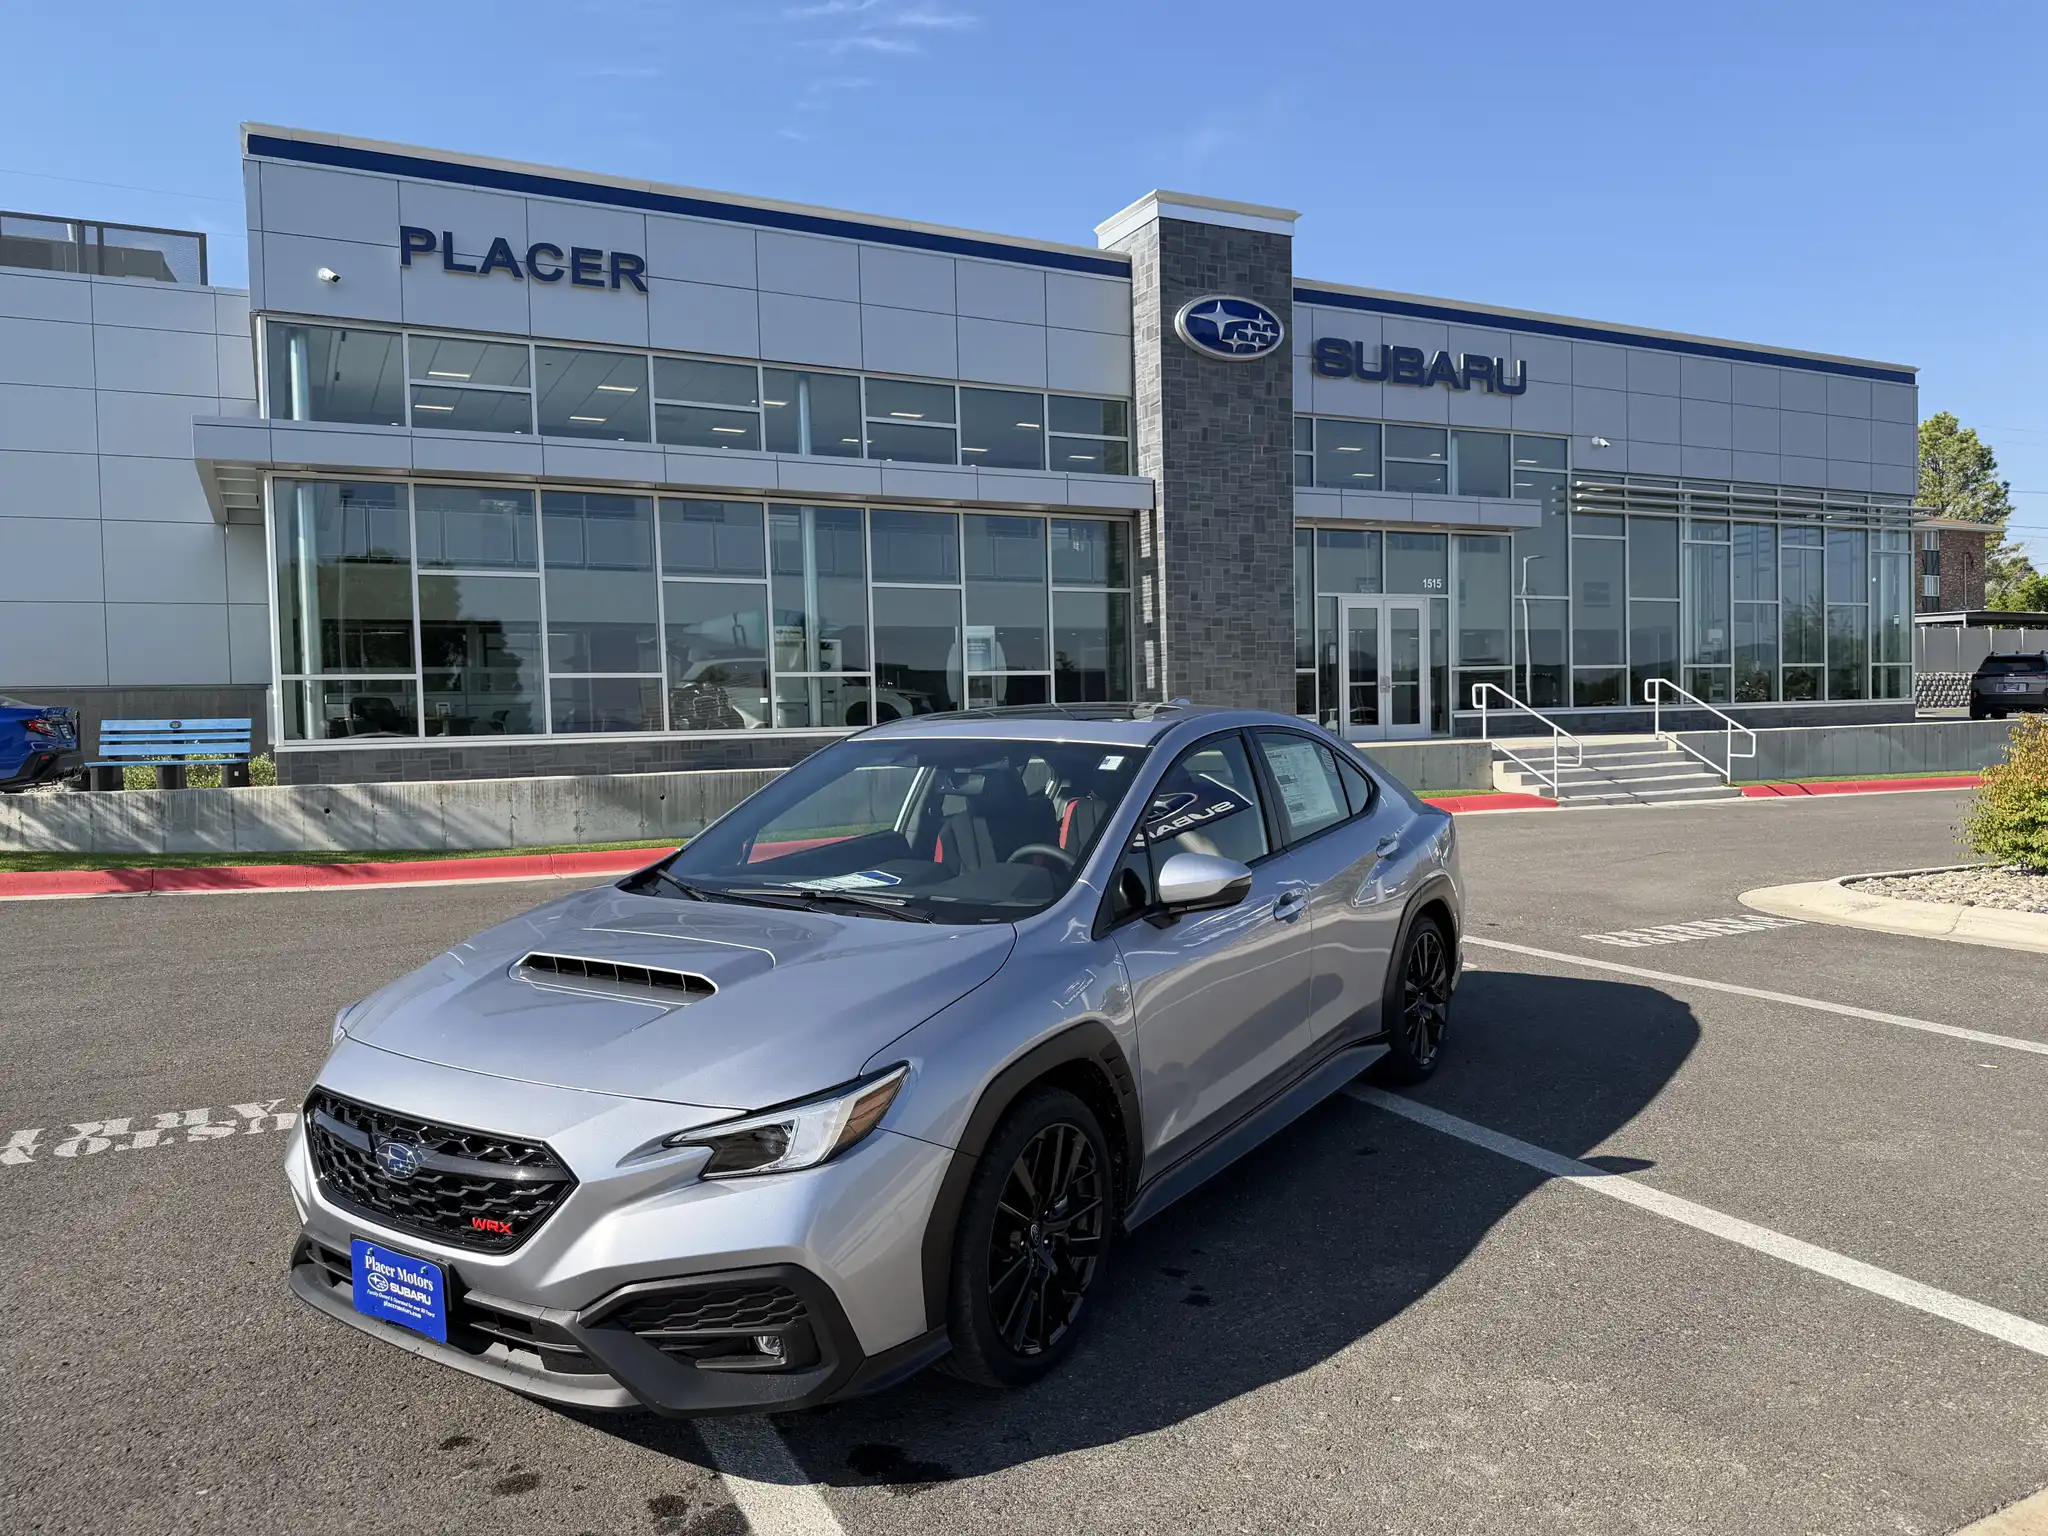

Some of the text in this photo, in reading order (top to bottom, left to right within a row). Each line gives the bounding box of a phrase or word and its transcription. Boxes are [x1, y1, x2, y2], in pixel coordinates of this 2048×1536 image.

[400, 225, 649, 293] PLACER
[1314, 337, 1527, 396] SUBARU
[1422, 578, 1442, 589] 1515
[472, 1217, 513, 1235] WRX
[365, 1255, 433, 1292] Placer Motors
[390, 1282, 431, 1306] SUBARU
